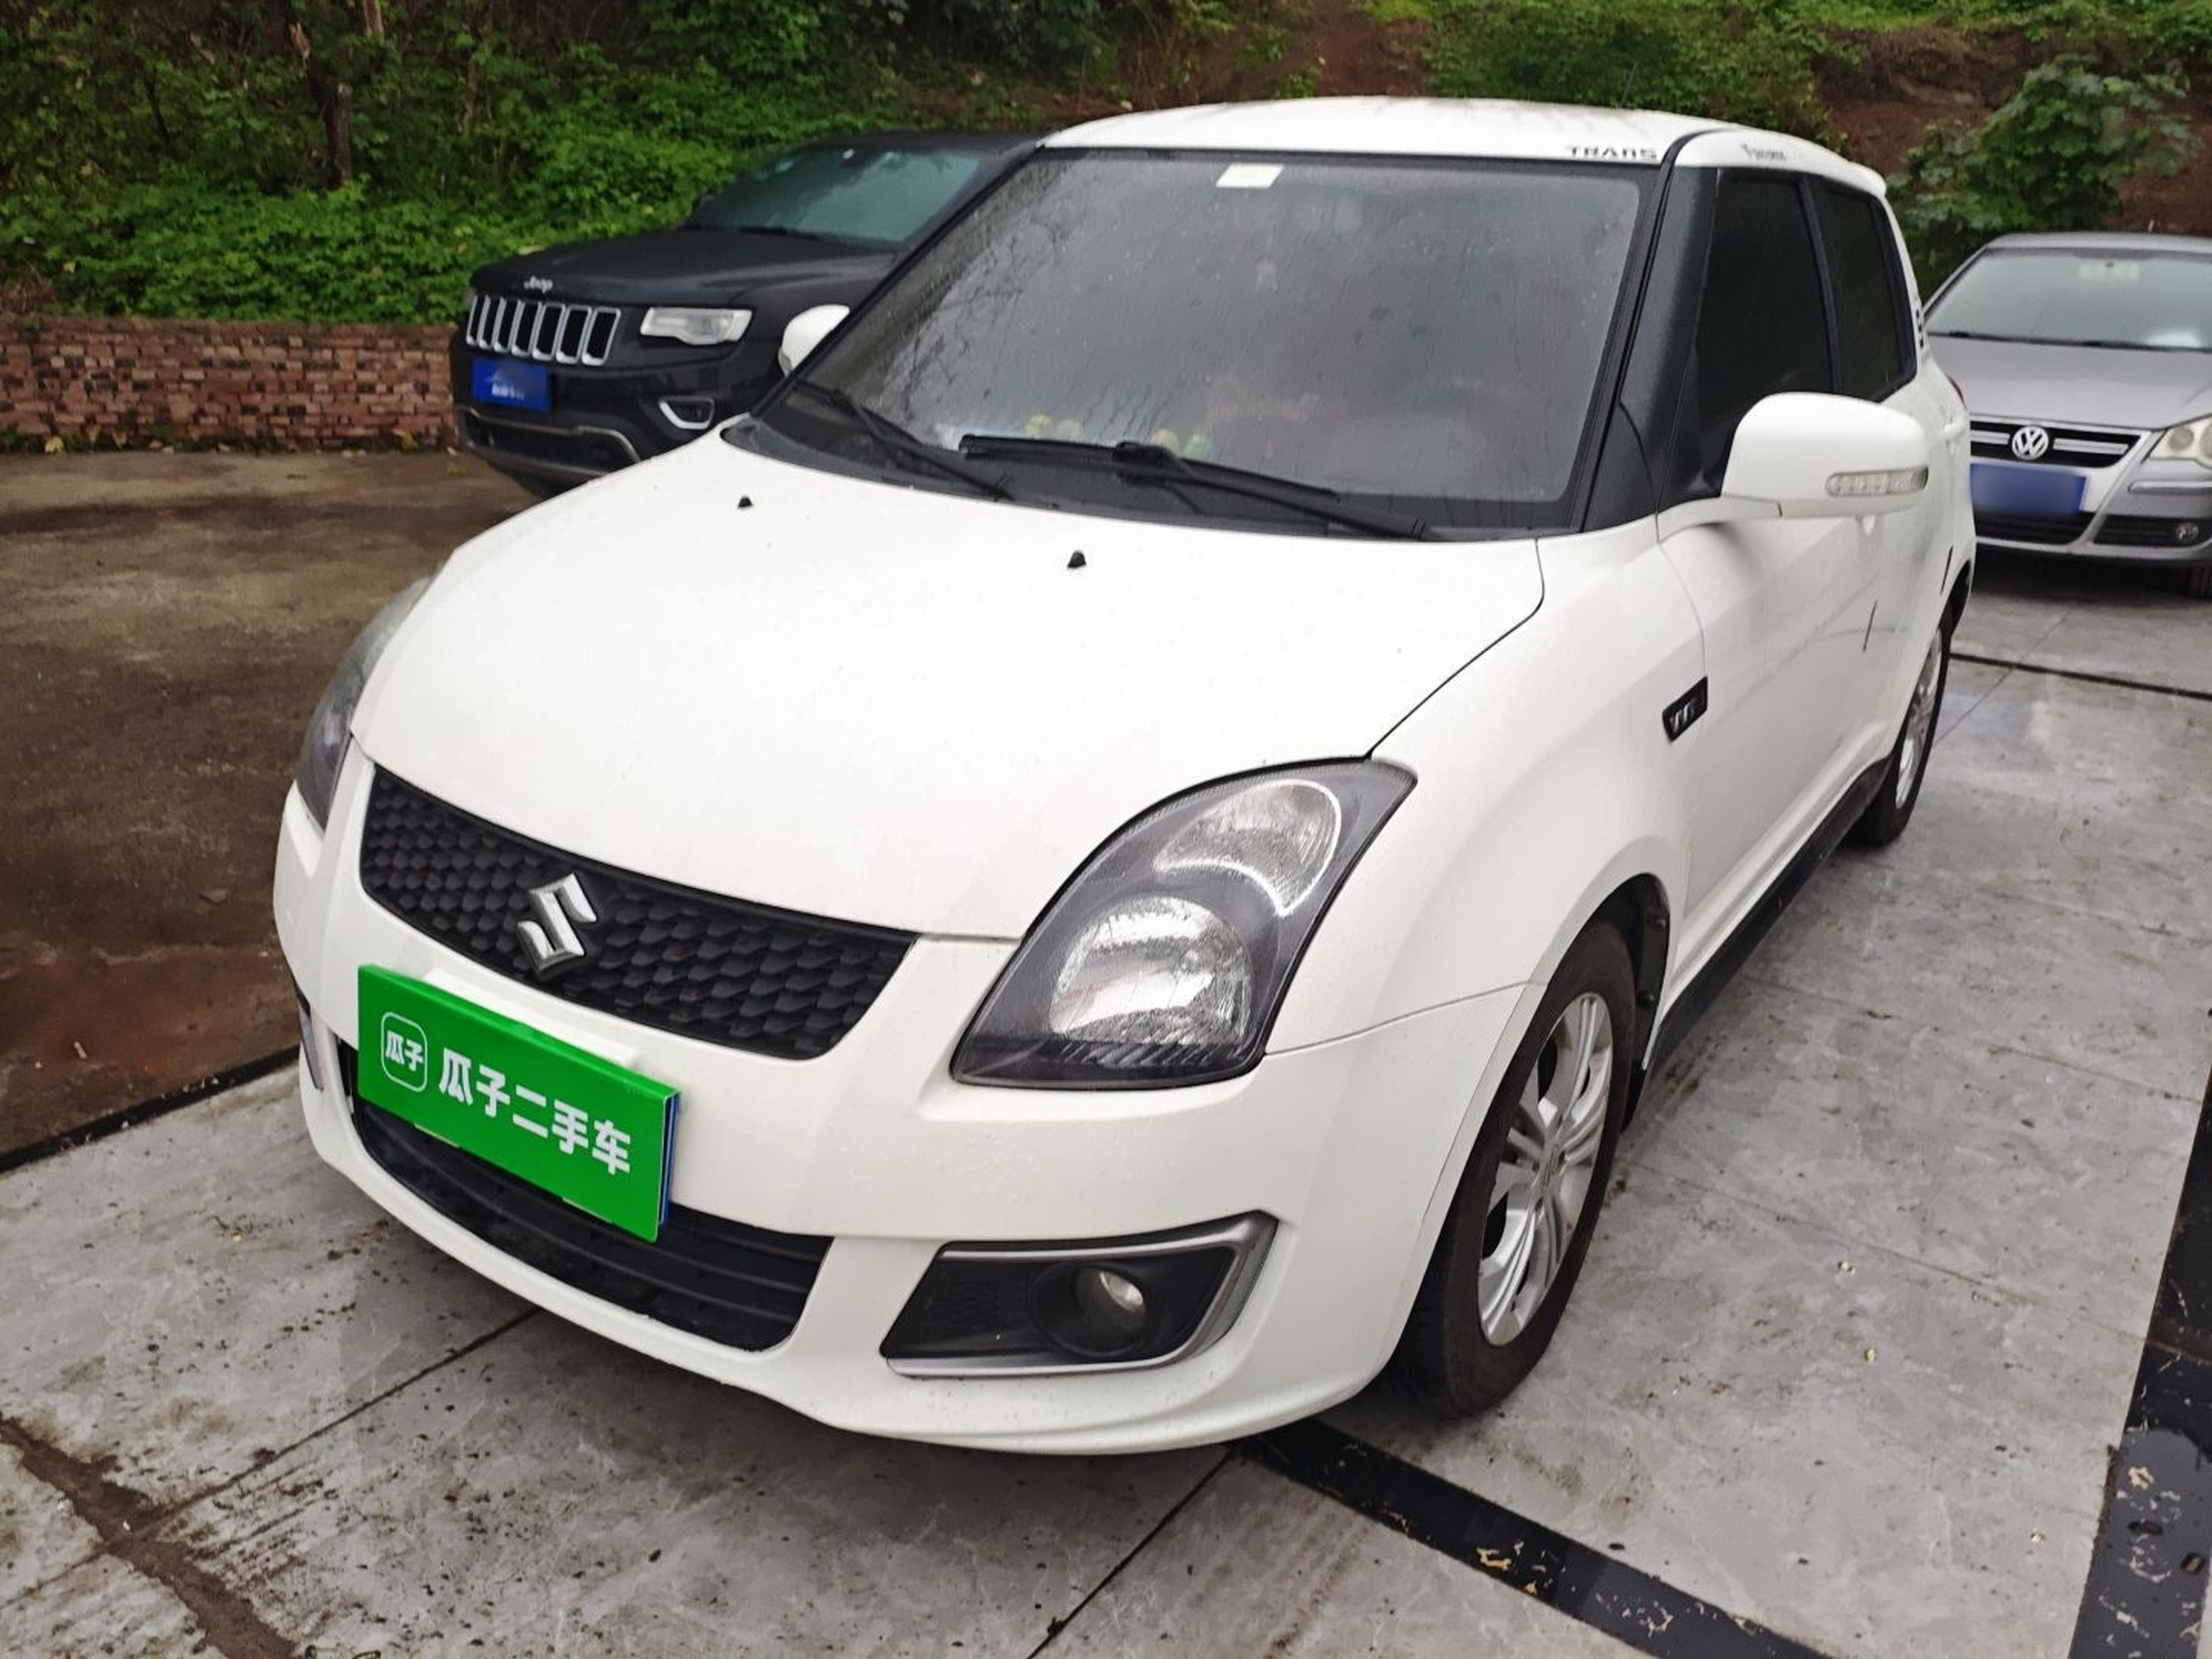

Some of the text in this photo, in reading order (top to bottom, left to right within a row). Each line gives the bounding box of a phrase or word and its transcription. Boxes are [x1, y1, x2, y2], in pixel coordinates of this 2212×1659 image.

[1565, 146, 1657, 160] TRANS
[524, 275, 553, 294] Jeep
[385, 1030, 423, 1071] 瓜子
[439, 1048, 631, 1175] 瓜子二手车
